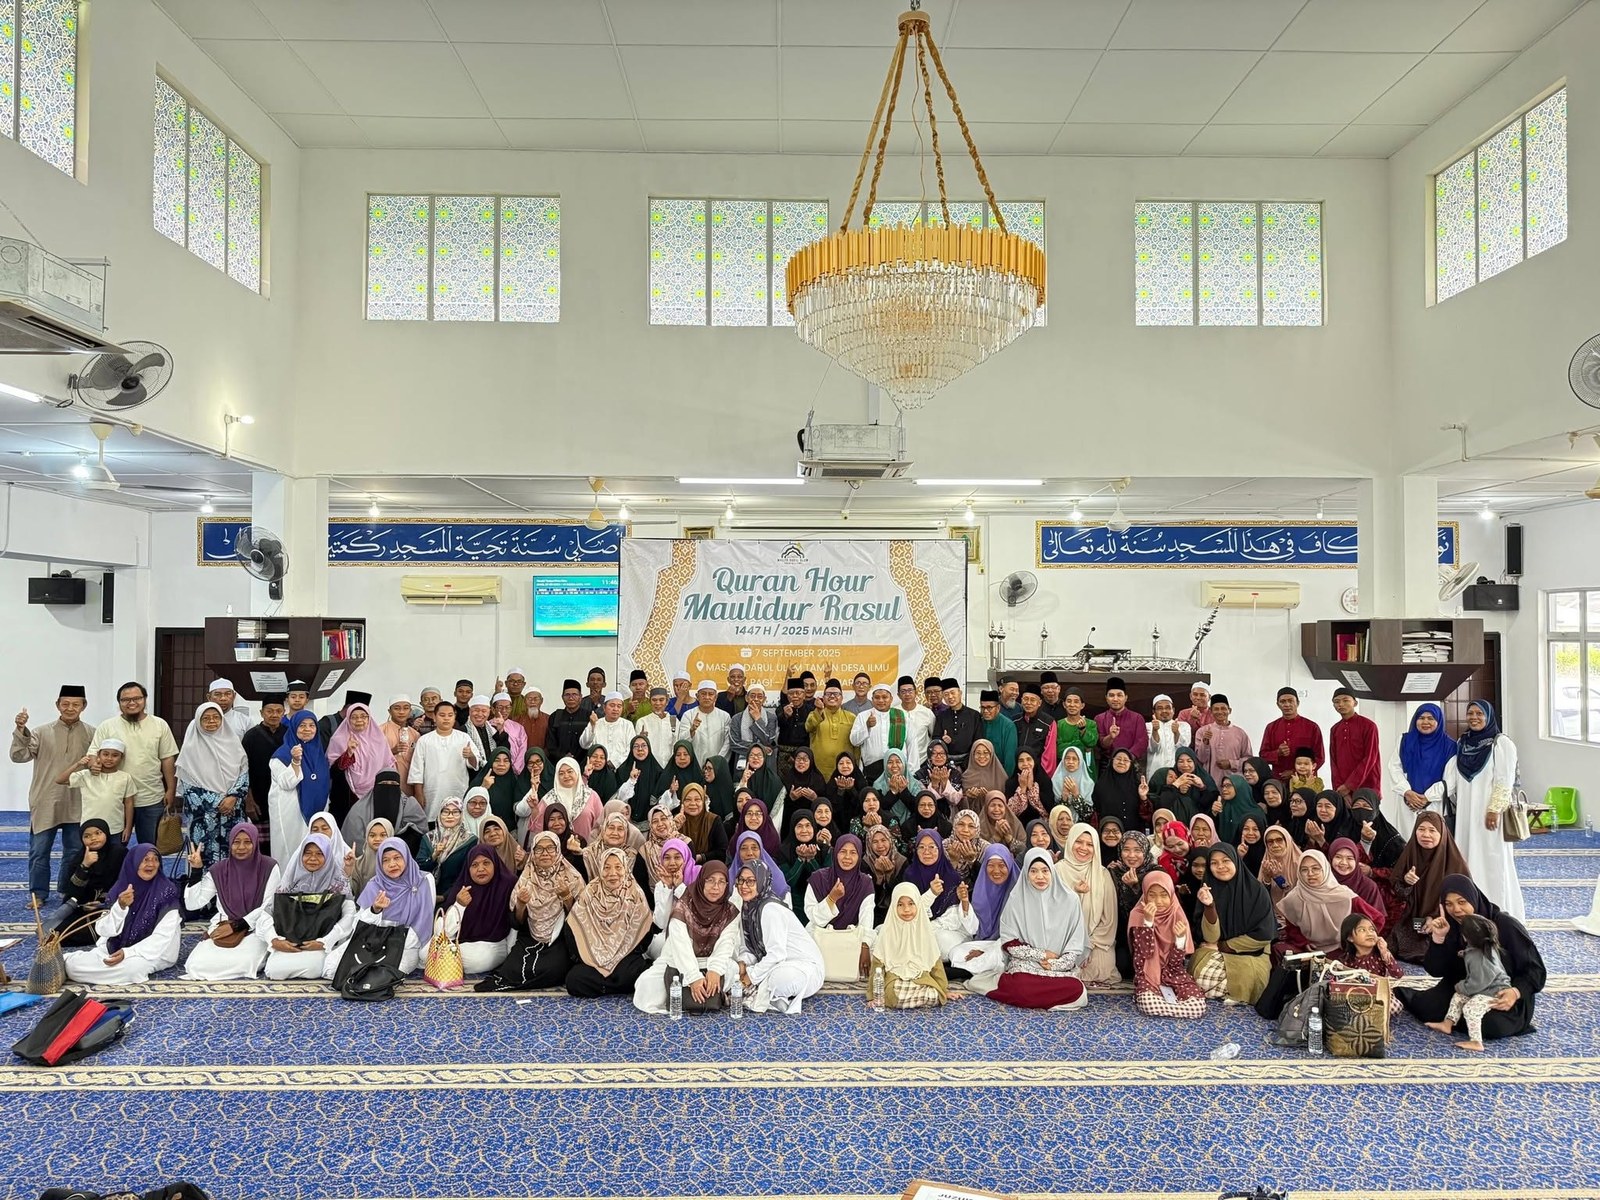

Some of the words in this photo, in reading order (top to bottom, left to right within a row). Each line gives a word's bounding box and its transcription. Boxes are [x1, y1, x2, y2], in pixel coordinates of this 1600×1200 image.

[712, 567, 800, 595] Quran
[805, 567, 874, 592] Hour
[683, 593, 813, 621] Maulidur
[820, 594, 903, 621] Rasul
[735, 626, 761, 636] 1447
[763, 626, 772, 636] H
[782, 626, 809, 636] 2025
[812, 626, 853, 636] MASIHI
[755, 648, 760, 657] 7
[762, 648, 814, 657] SEPTEMBER
[818, 648, 841, 657] 2025
[744, 663, 774, 672] DARUL
[777, 663, 802, 672] ULM
[804, 663, 838, 672] TAMN
[841, 663, 865, 672] DESA
[868, 663, 889, 672] ILMU
